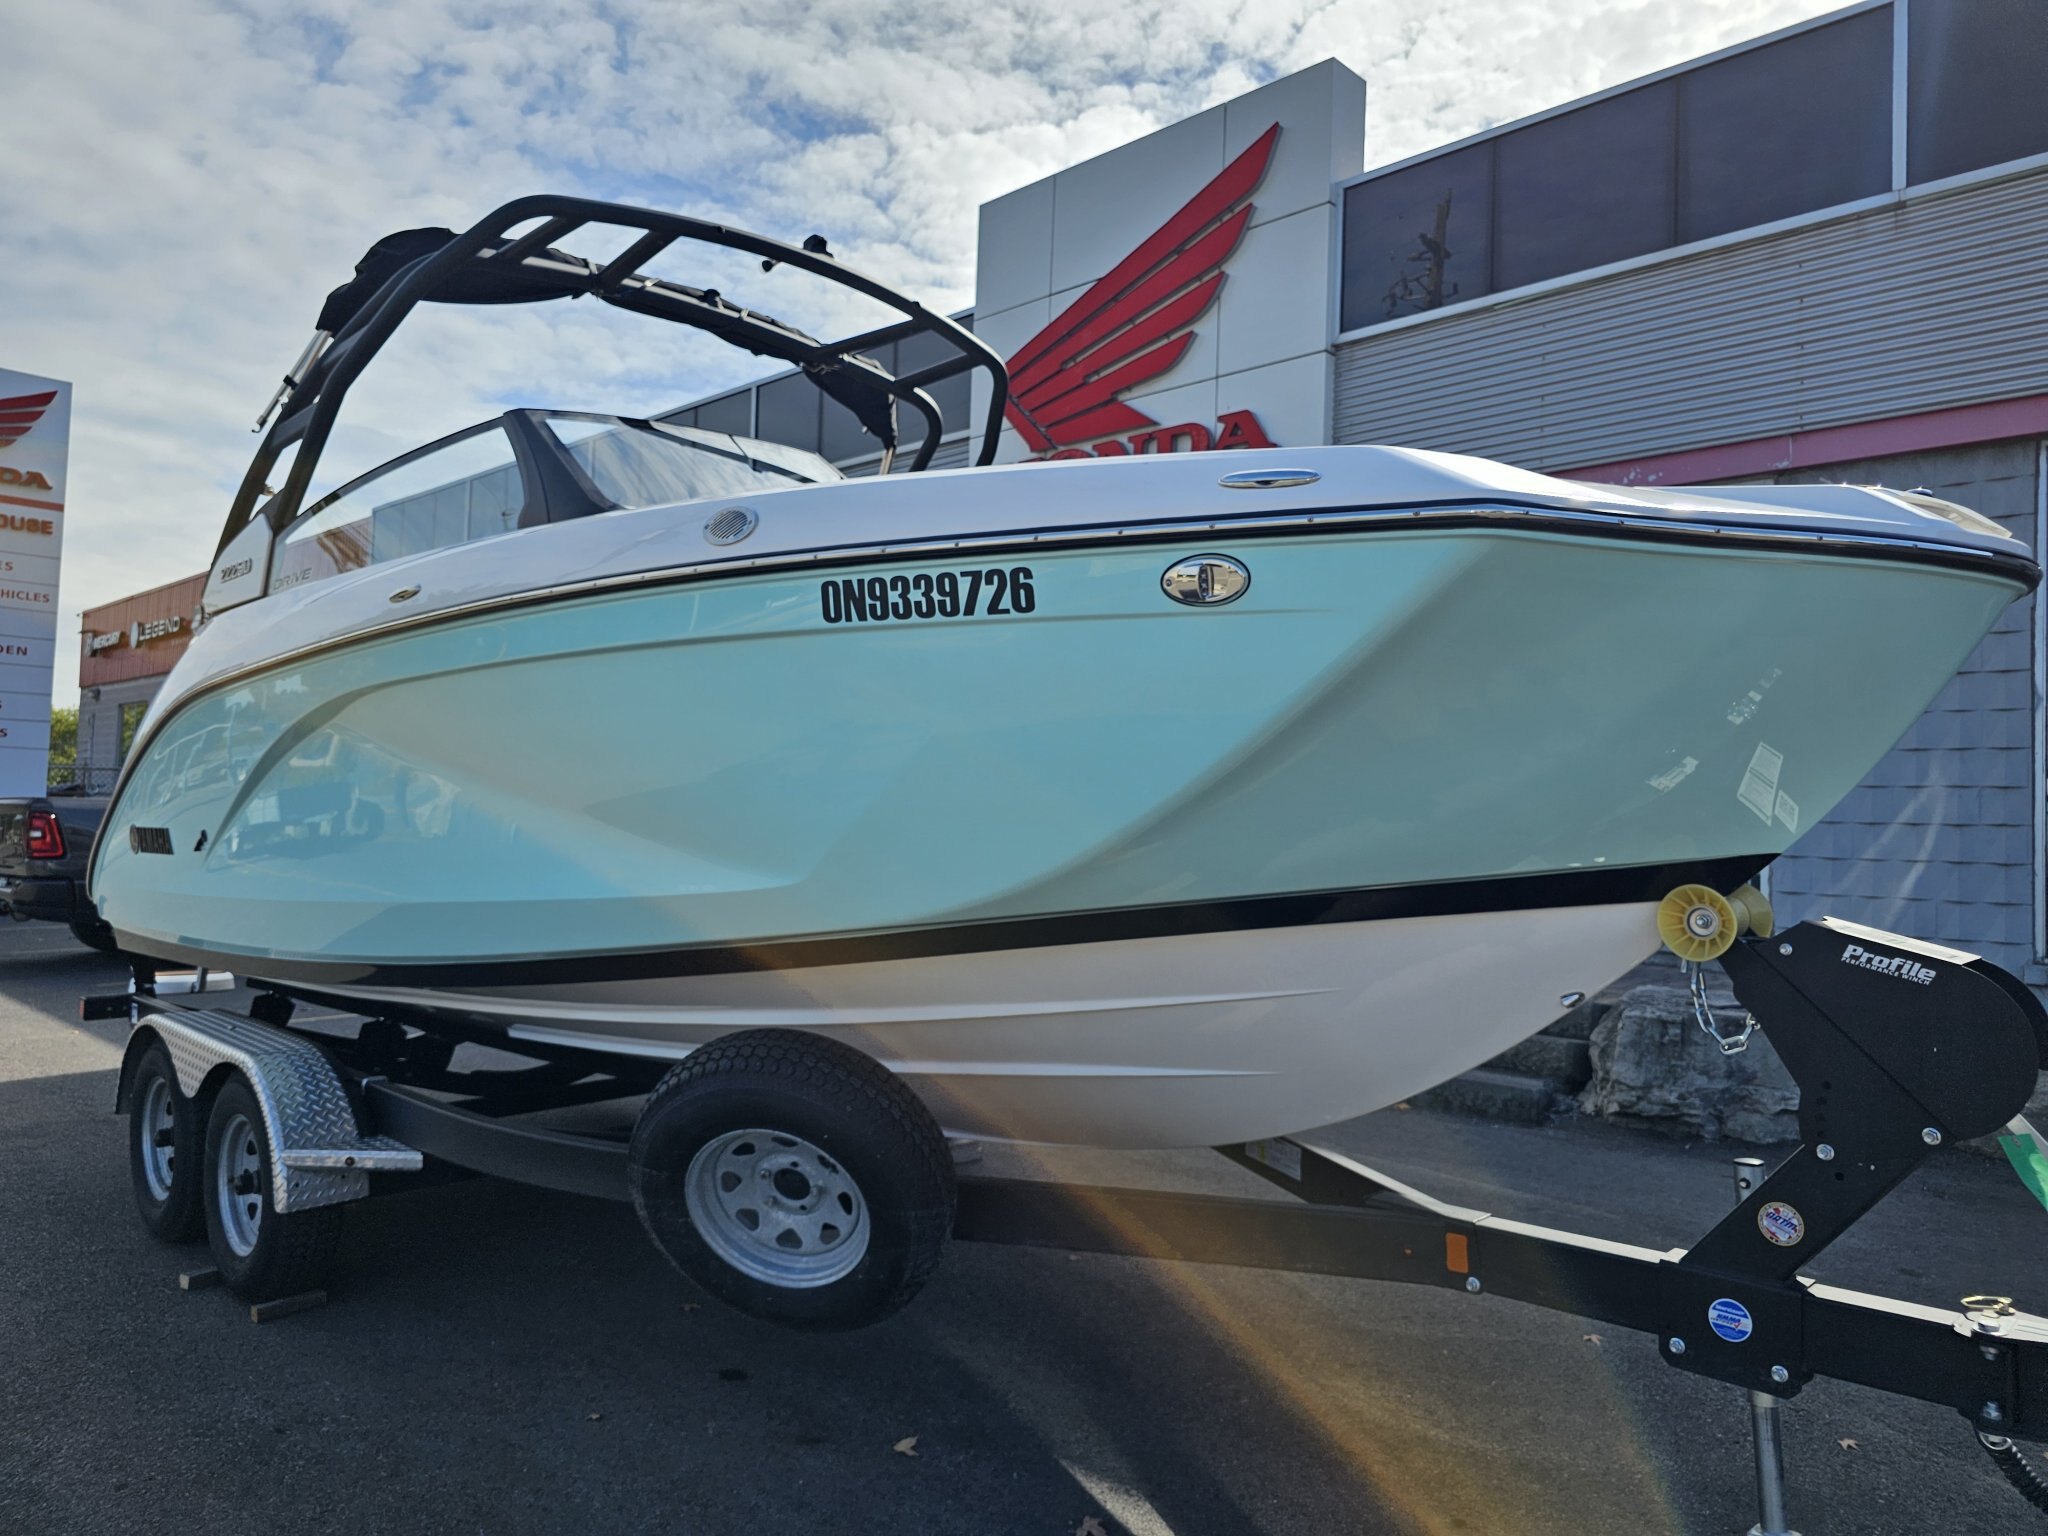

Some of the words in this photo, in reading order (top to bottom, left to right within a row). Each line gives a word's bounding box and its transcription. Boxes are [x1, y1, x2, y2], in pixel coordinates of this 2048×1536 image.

[821, 566, 1036, 624] ON9339726
[138, 615, 181, 641] LEGEND
[1841, 956, 1900, 977] PERFORMANCE
[1901, 973, 1931, 986] WINCH
[1842, 944, 1937, 981] Profile
